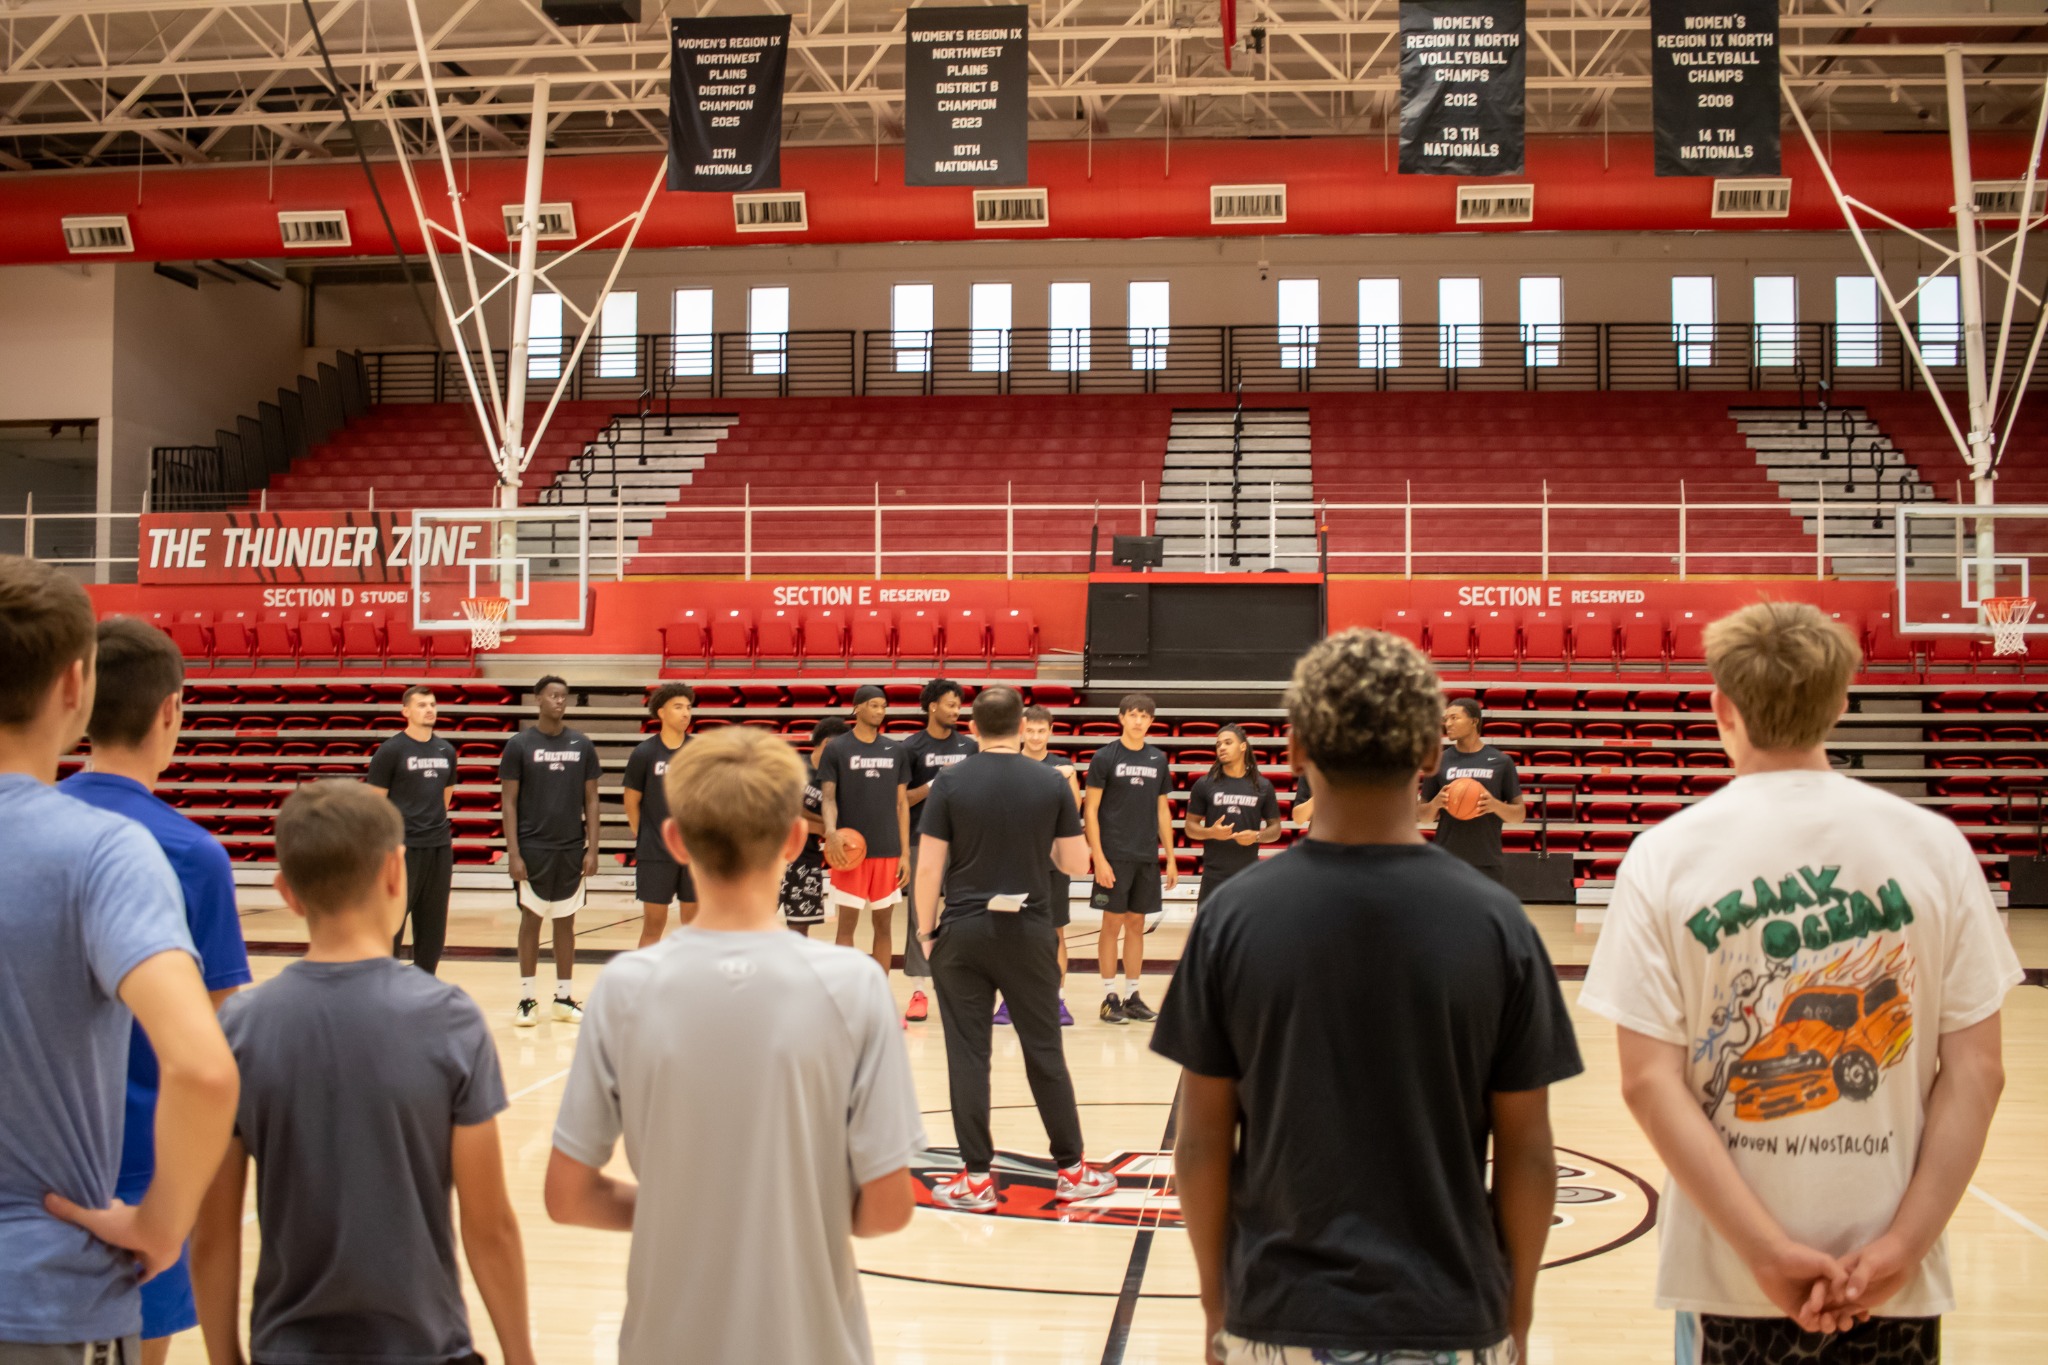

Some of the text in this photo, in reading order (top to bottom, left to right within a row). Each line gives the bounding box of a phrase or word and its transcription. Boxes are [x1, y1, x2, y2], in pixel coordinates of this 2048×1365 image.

[1433, 16, 1494, 30] WOMEN'S
[1685, 14, 1746, 30] WOMEN'S
[911, 28, 1022, 42] WOMEN'S REGION IX
[1406, 34, 1520, 48] REGION IX NORTH
[1658, 33, 1774, 48] REGION IX NORTH
[678, 36, 781, 49] WOMEN'S REGION IX
[696, 53, 761, 64] NORTHWEST
[932, 46, 1003, 60] NORTHWEST
[1419, 51, 1508, 66] VOLLEYBALL
[1672, 52, 1760, 66] VOLLEYBALL
[709, 69, 747, 80] PLAINS
[947, 64, 988, 77] PLAINS
[1435, 68, 1490, 82] CHAMPS
[1688, 70, 1744, 83] CHAMPS
[699, 84, 756, 96] DISTRICT B
[936, 81, 999, 94] DISTRICT B
[699, 100, 754, 111] CHAMPION
[938, 98, 997, 112] CHAMPION
[1444, 93, 1478, 107] 2012
[1698, 94, 1734, 108] 2008
[711, 116, 741, 127] 2025
[952, 117, 982, 129] 2023
[1444, 127, 1480, 141] 13 TH
[1698, 129, 1736, 142] 14 TH
[712, 148, 736, 159] 11TH
[954, 144, 980, 156] 10TH
[1424, 142, 1500, 157] NATIONALS
[1680, 146, 1754, 159] NATIONALS
[695, 164, 753, 175] NATIONALS
[935, 160, 998, 172] NATIONALS
[148, 526, 482, 568] THE THUNDER ZONE
[263, 588, 431, 607] SECTION D STUDES
[773, 586, 950, 606] SECTION E RESERVED
[1458, 586, 1644, 606] SECTION E RESERVED
[1686, 865, 1850, 954] FRANK
[1762, 878, 1914, 959] OCEAN
